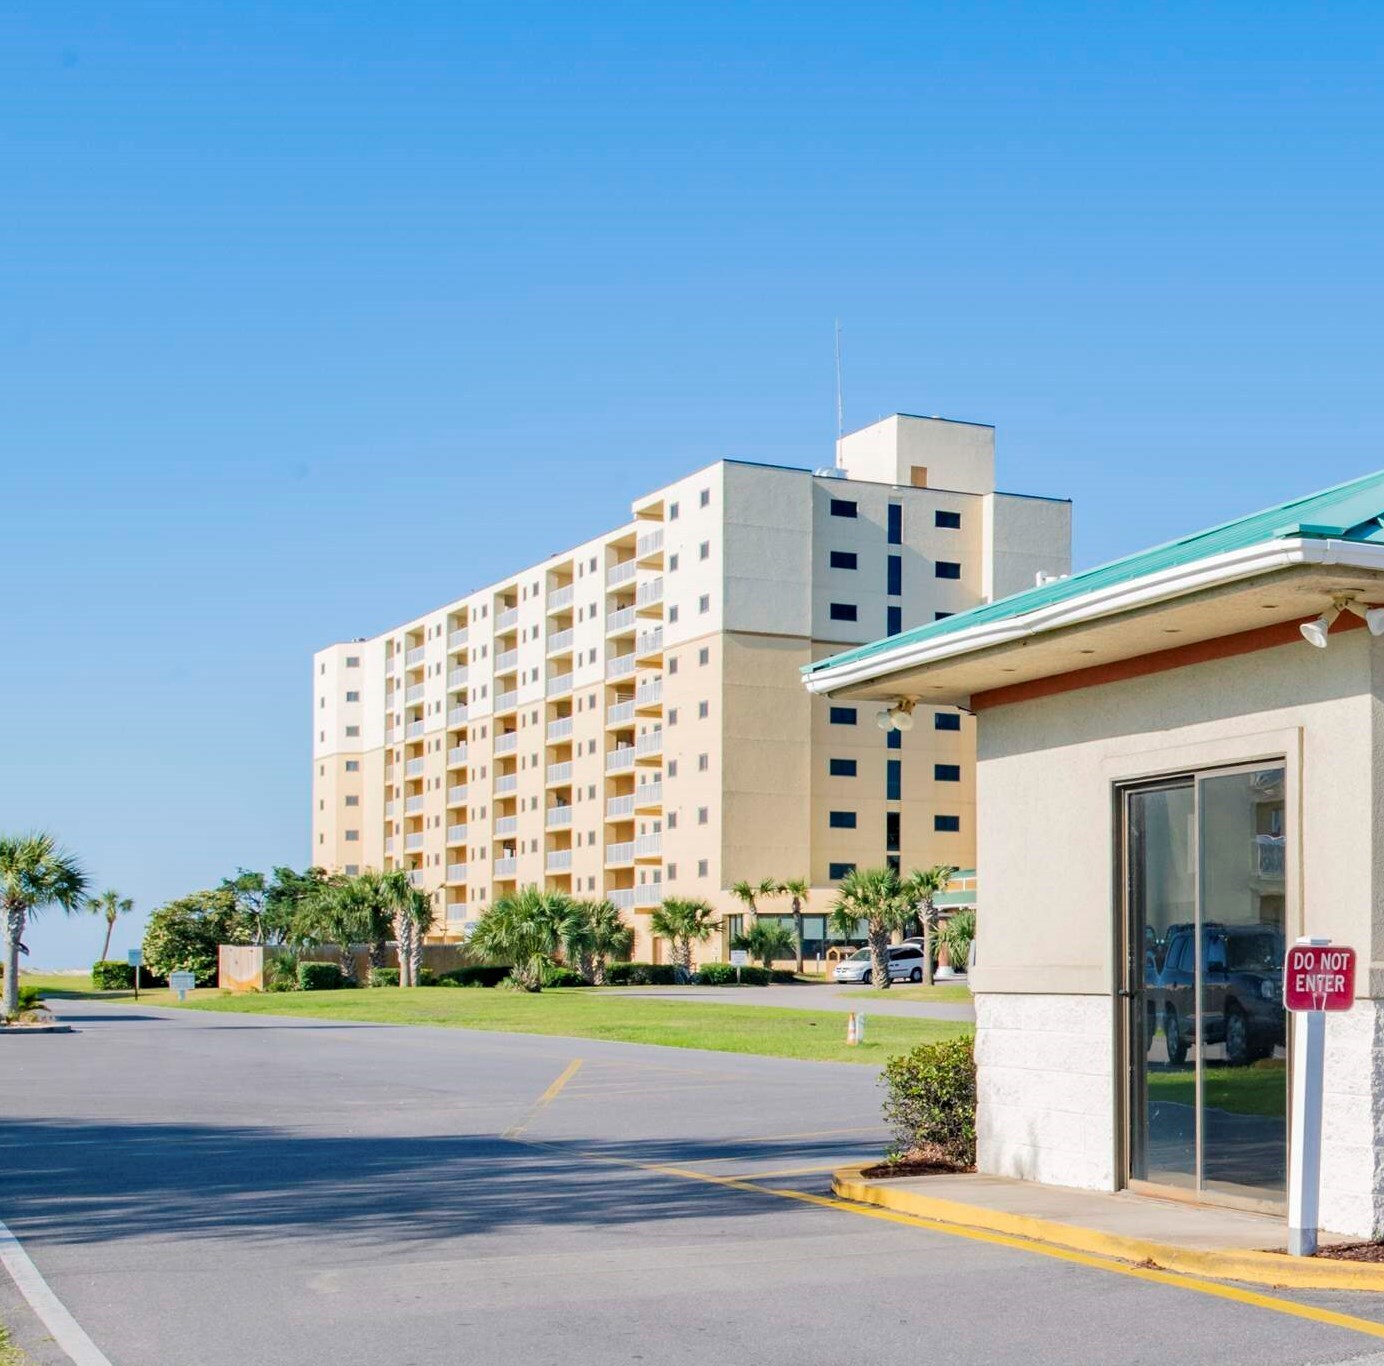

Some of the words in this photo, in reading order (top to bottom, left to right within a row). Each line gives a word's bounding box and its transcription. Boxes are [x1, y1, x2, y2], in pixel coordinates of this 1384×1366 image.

[1294, 952, 1315, 970] DO
[1321, 953, 1350, 970] NOT
[1295, 974, 1345, 992] ENTER
